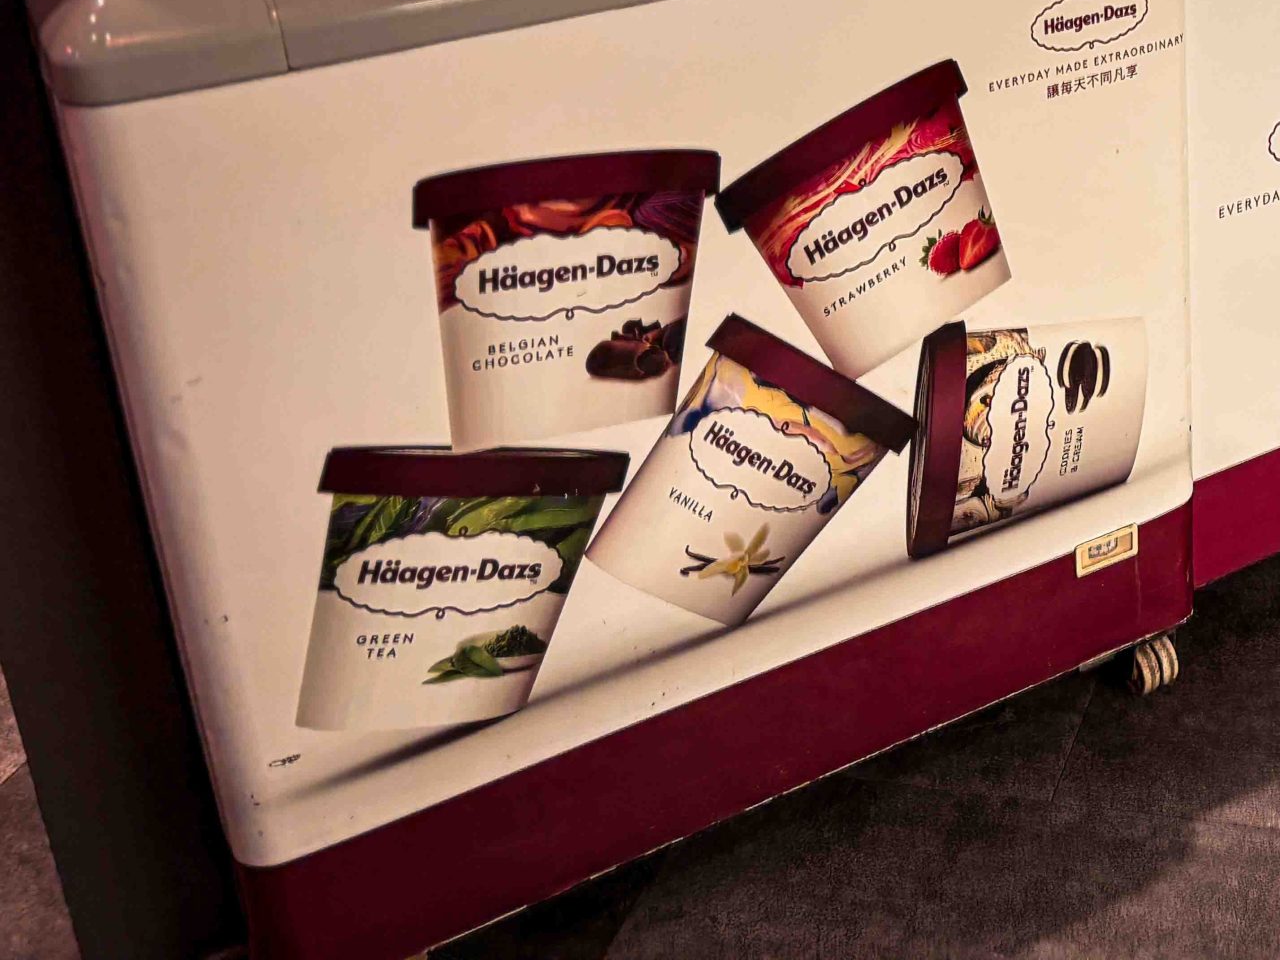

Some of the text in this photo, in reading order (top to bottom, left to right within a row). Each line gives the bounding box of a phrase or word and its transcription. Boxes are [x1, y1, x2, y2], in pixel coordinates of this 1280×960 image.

[1043, 3, 1137, 36] Häagen-Dazs
[989, 32, 1184, 93] EVERYDAY MADE EXTRAORDINARY
[1046, 64, 1139, 100] 讓每天不同凡享
[803, 167, 949, 266] Häagen-Dazs
[478, 254, 660, 294] Häagen-Dazs
[823, 255, 909, 318] STRAWBERRY
[471, 345, 575, 372] CHOCOLATE
[487, 334, 560, 356] BELGIAN
[1001, 365, 1031, 493] Häagen-Dazs
[702, 420, 818, 495] Häagen-Dazs
[667, 486, 714, 524] VANILLA
[356, 557, 543, 591] Häagen-Dazs
[356, 632, 415, 647] GREEN
[366, 647, 398, 659] TEA
